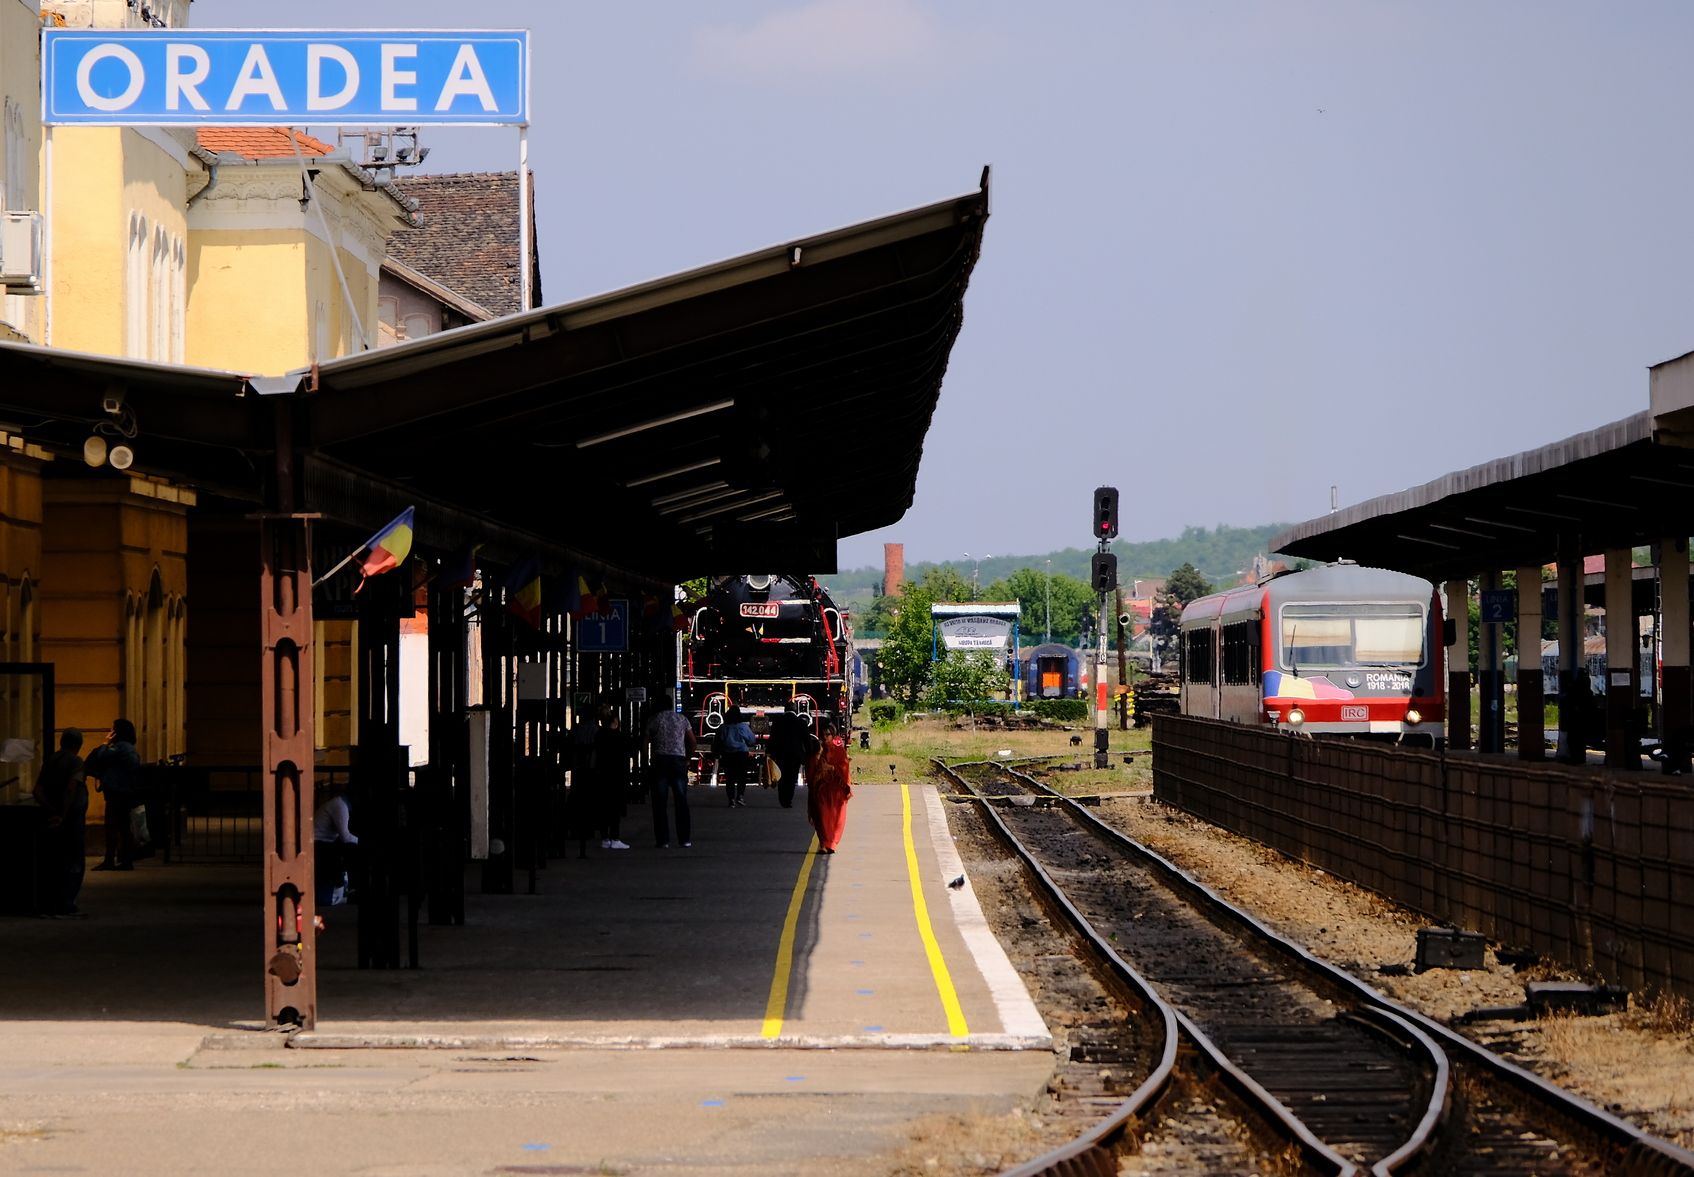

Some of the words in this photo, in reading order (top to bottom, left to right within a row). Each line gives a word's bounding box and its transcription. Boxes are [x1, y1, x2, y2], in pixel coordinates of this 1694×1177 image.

[76, 43, 499, 112] ORADEA
[1492, 604, 1503, 618] 2
[598, 622, 606, 644] 1
[1367, 681, 1386, 690] 1918
[1391, 681, 1410, 690] 2018
